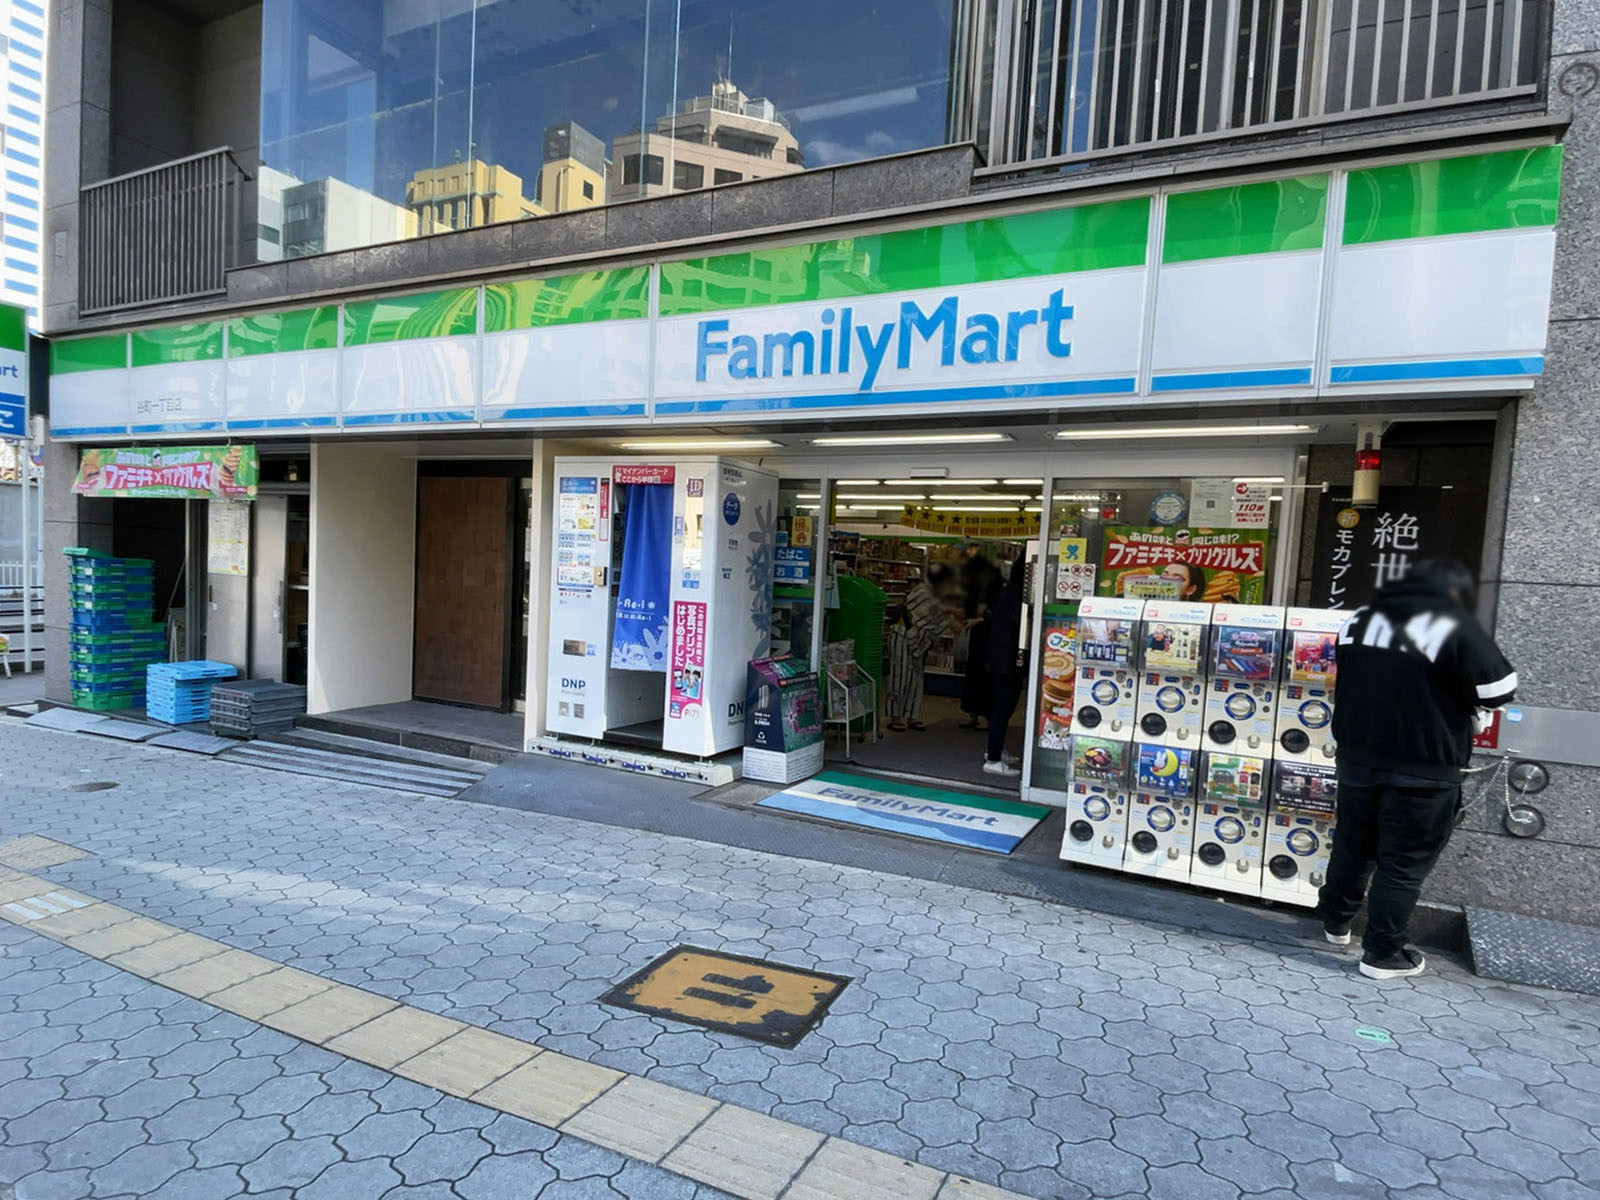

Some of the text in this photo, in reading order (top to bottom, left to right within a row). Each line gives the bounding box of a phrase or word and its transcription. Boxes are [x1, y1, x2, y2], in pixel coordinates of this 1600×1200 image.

[696, 288, 1075, 392] FamilyMart
[0, 364, 18, 379] rt
[1129, 532, 1174, 546] あの味と
[776, 549, 804, 560] たばこ
[1109, 543, 1260, 571] ファミチキ×プリングルズ
[674, 604, 686, 667] はじめました
[562, 677, 586, 690] DNP
[817, 787, 1000, 826] FamilyMart
